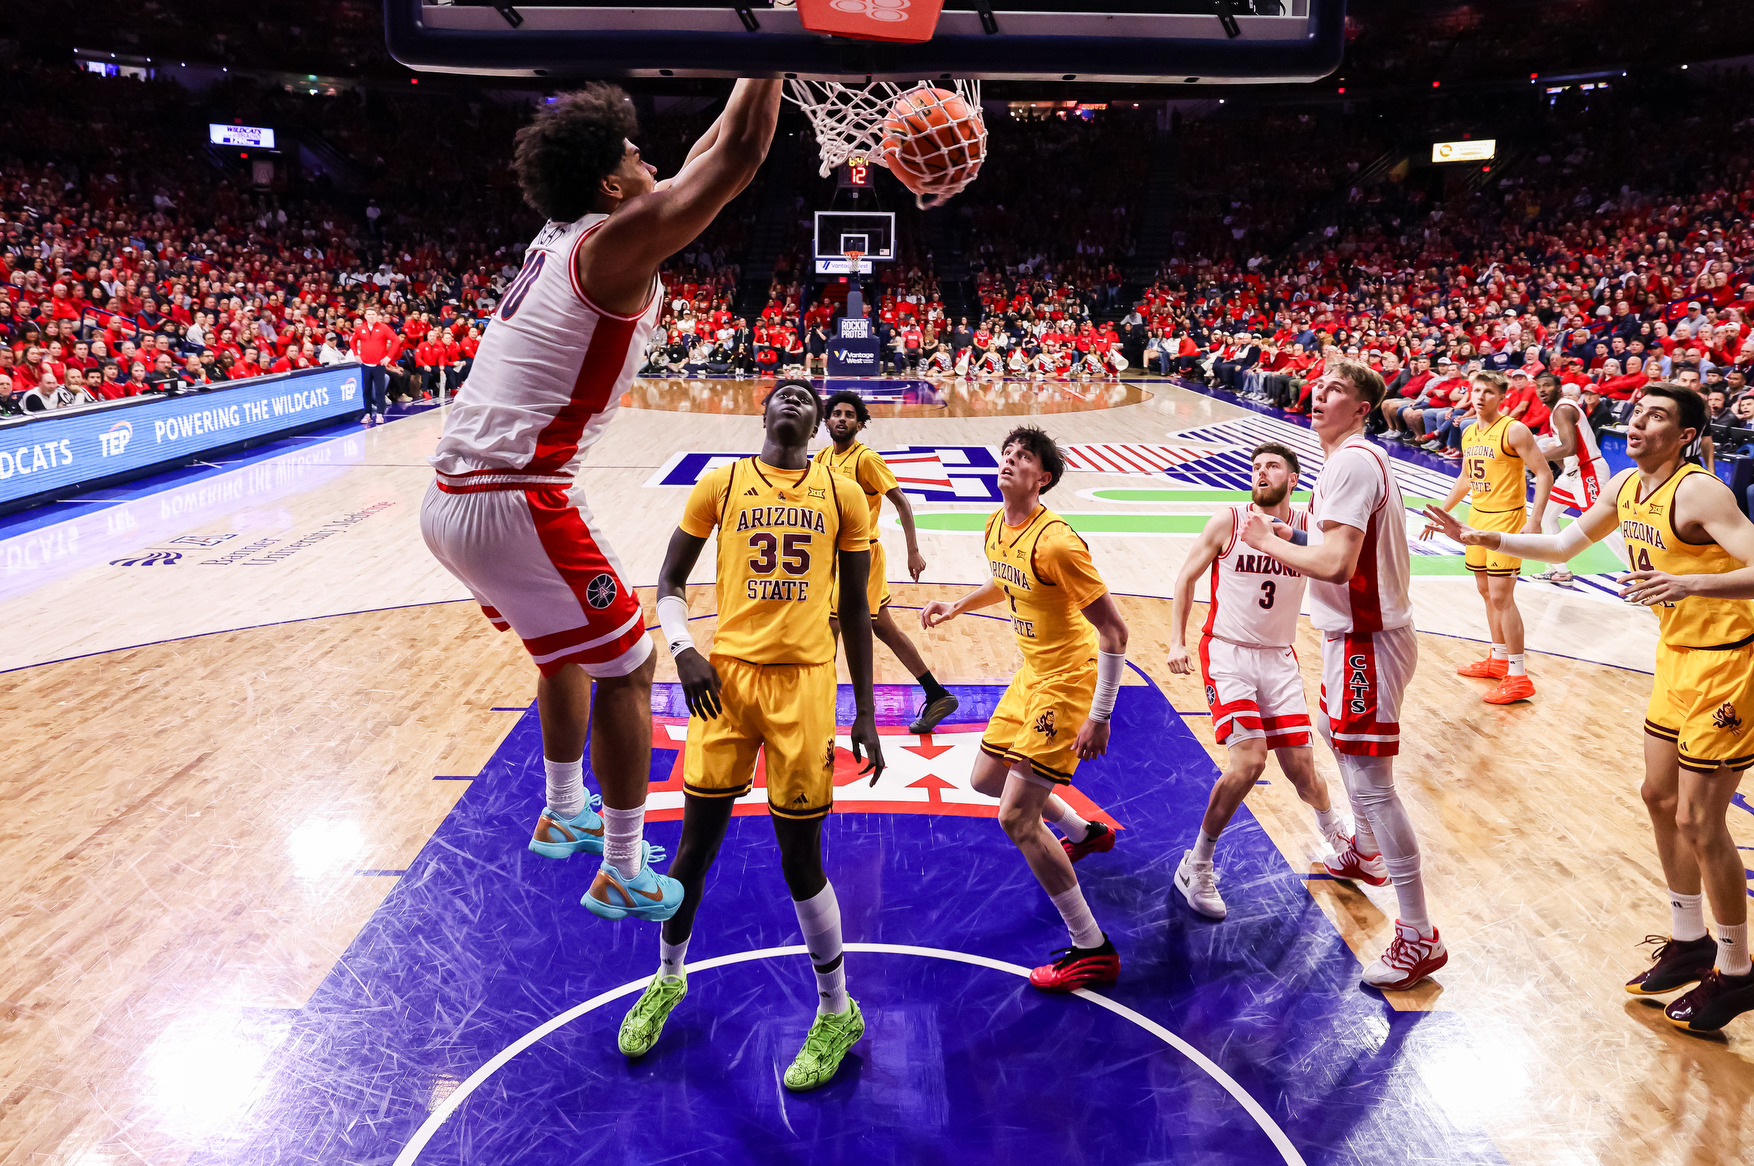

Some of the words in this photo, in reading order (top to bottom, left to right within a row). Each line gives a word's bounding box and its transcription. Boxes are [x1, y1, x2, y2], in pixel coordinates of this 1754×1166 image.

[227, 126, 262, 134] WILDCATS
[851, 166, 867, 185] 12
[841, 320, 869, 330] ROCKIN'
[841, 330, 868, 339] PROTEIN
[340, 383, 356, 401] TEP
[154, 405, 240, 443] POWERING
[243, 400, 270, 423] THE
[271, 387, 330, 417] WILDCATS
[99, 429, 130, 458] TEP
[1468, 458, 1486, 480] 15
[1469, 481, 1492, 492] TATE
[1586, 476, 1598, 503] CATS
[736, 506, 826, 534] ARIZONA
[198, 537, 281, 566] Banner
[241, 528, 347, 566] University
[748, 532, 812, 576] 35
[1628, 544, 1655, 572] 14
[989, 560, 1032, 591] RIZONA
[1235, 554, 1300, 577] ARIZON
[747, 580, 809, 602] STATE
[1258, 580, 1277, 610] 3
[1349, 655, 1369, 714] CATS
